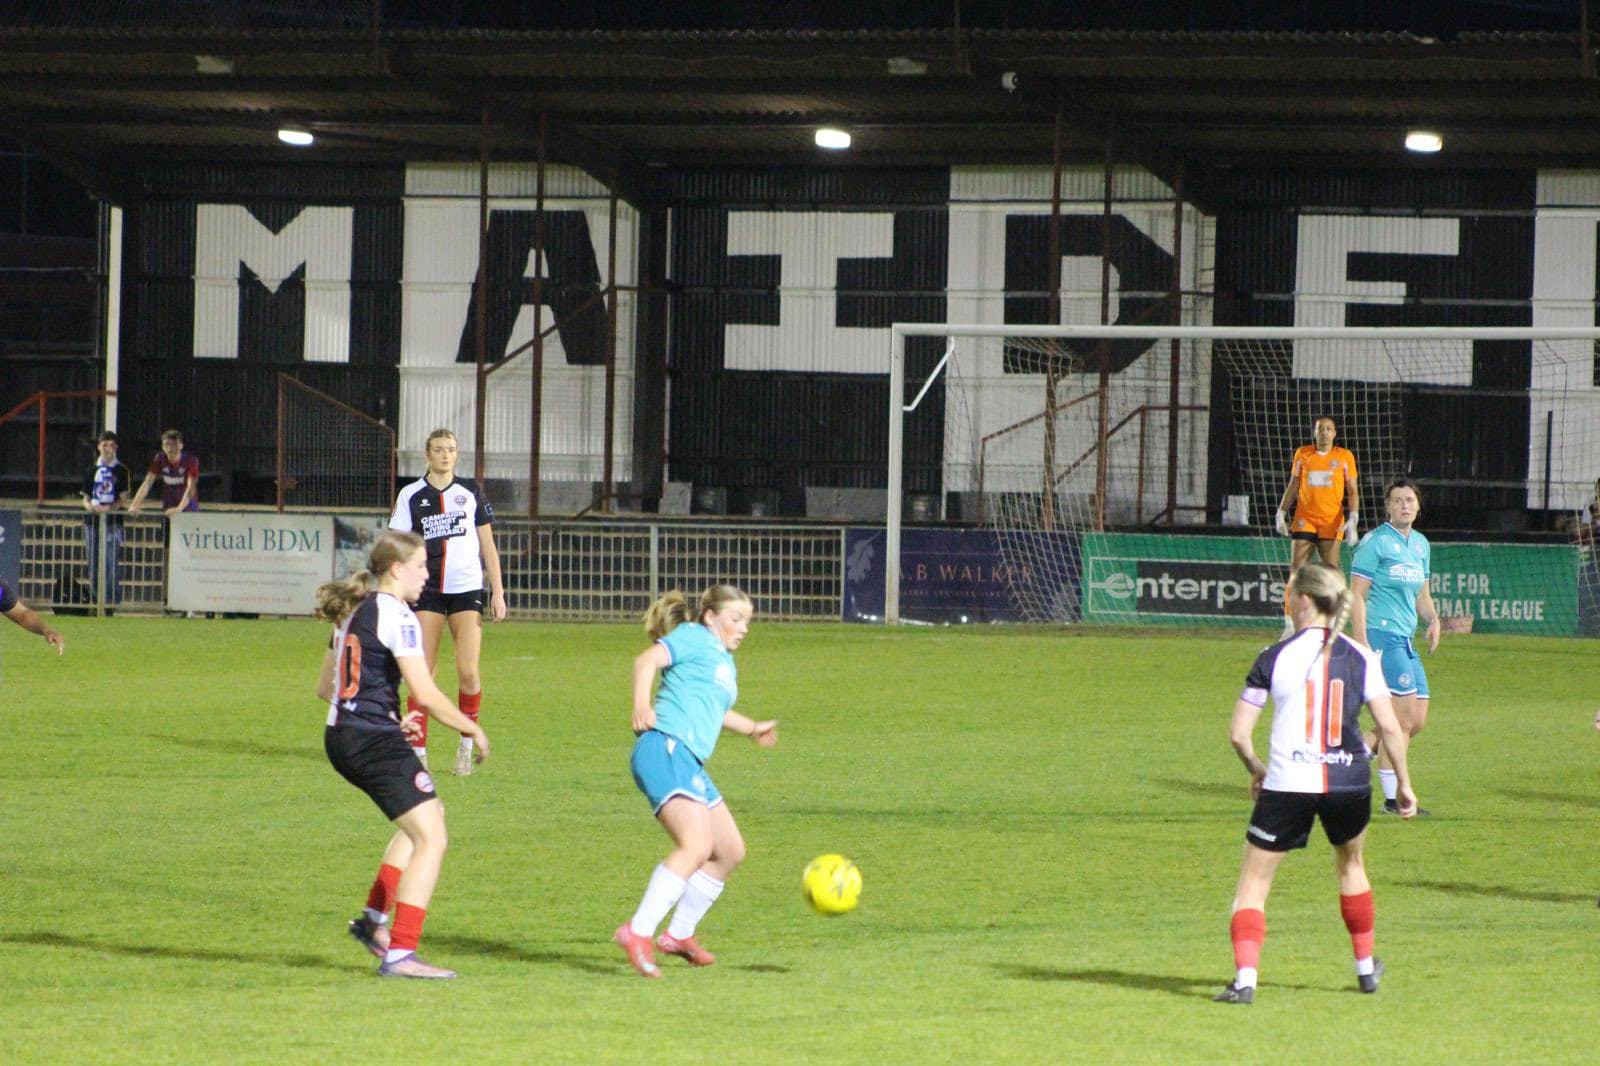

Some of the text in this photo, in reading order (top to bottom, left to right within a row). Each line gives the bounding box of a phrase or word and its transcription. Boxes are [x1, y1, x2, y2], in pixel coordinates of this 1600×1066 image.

[193, 203, 1600, 386] MAIDE
[423, 518, 456, 529] AGAINST
[424, 524, 451, 534] LIVING
[181, 527, 322, 553] virtual BDM
[1104, 572, 1284, 609] enterpris
[1457, 573, 1490, 595] FOR
[1480, 600, 1545, 621] LEAGUE
[1305, 678, 1343, 747] 11
